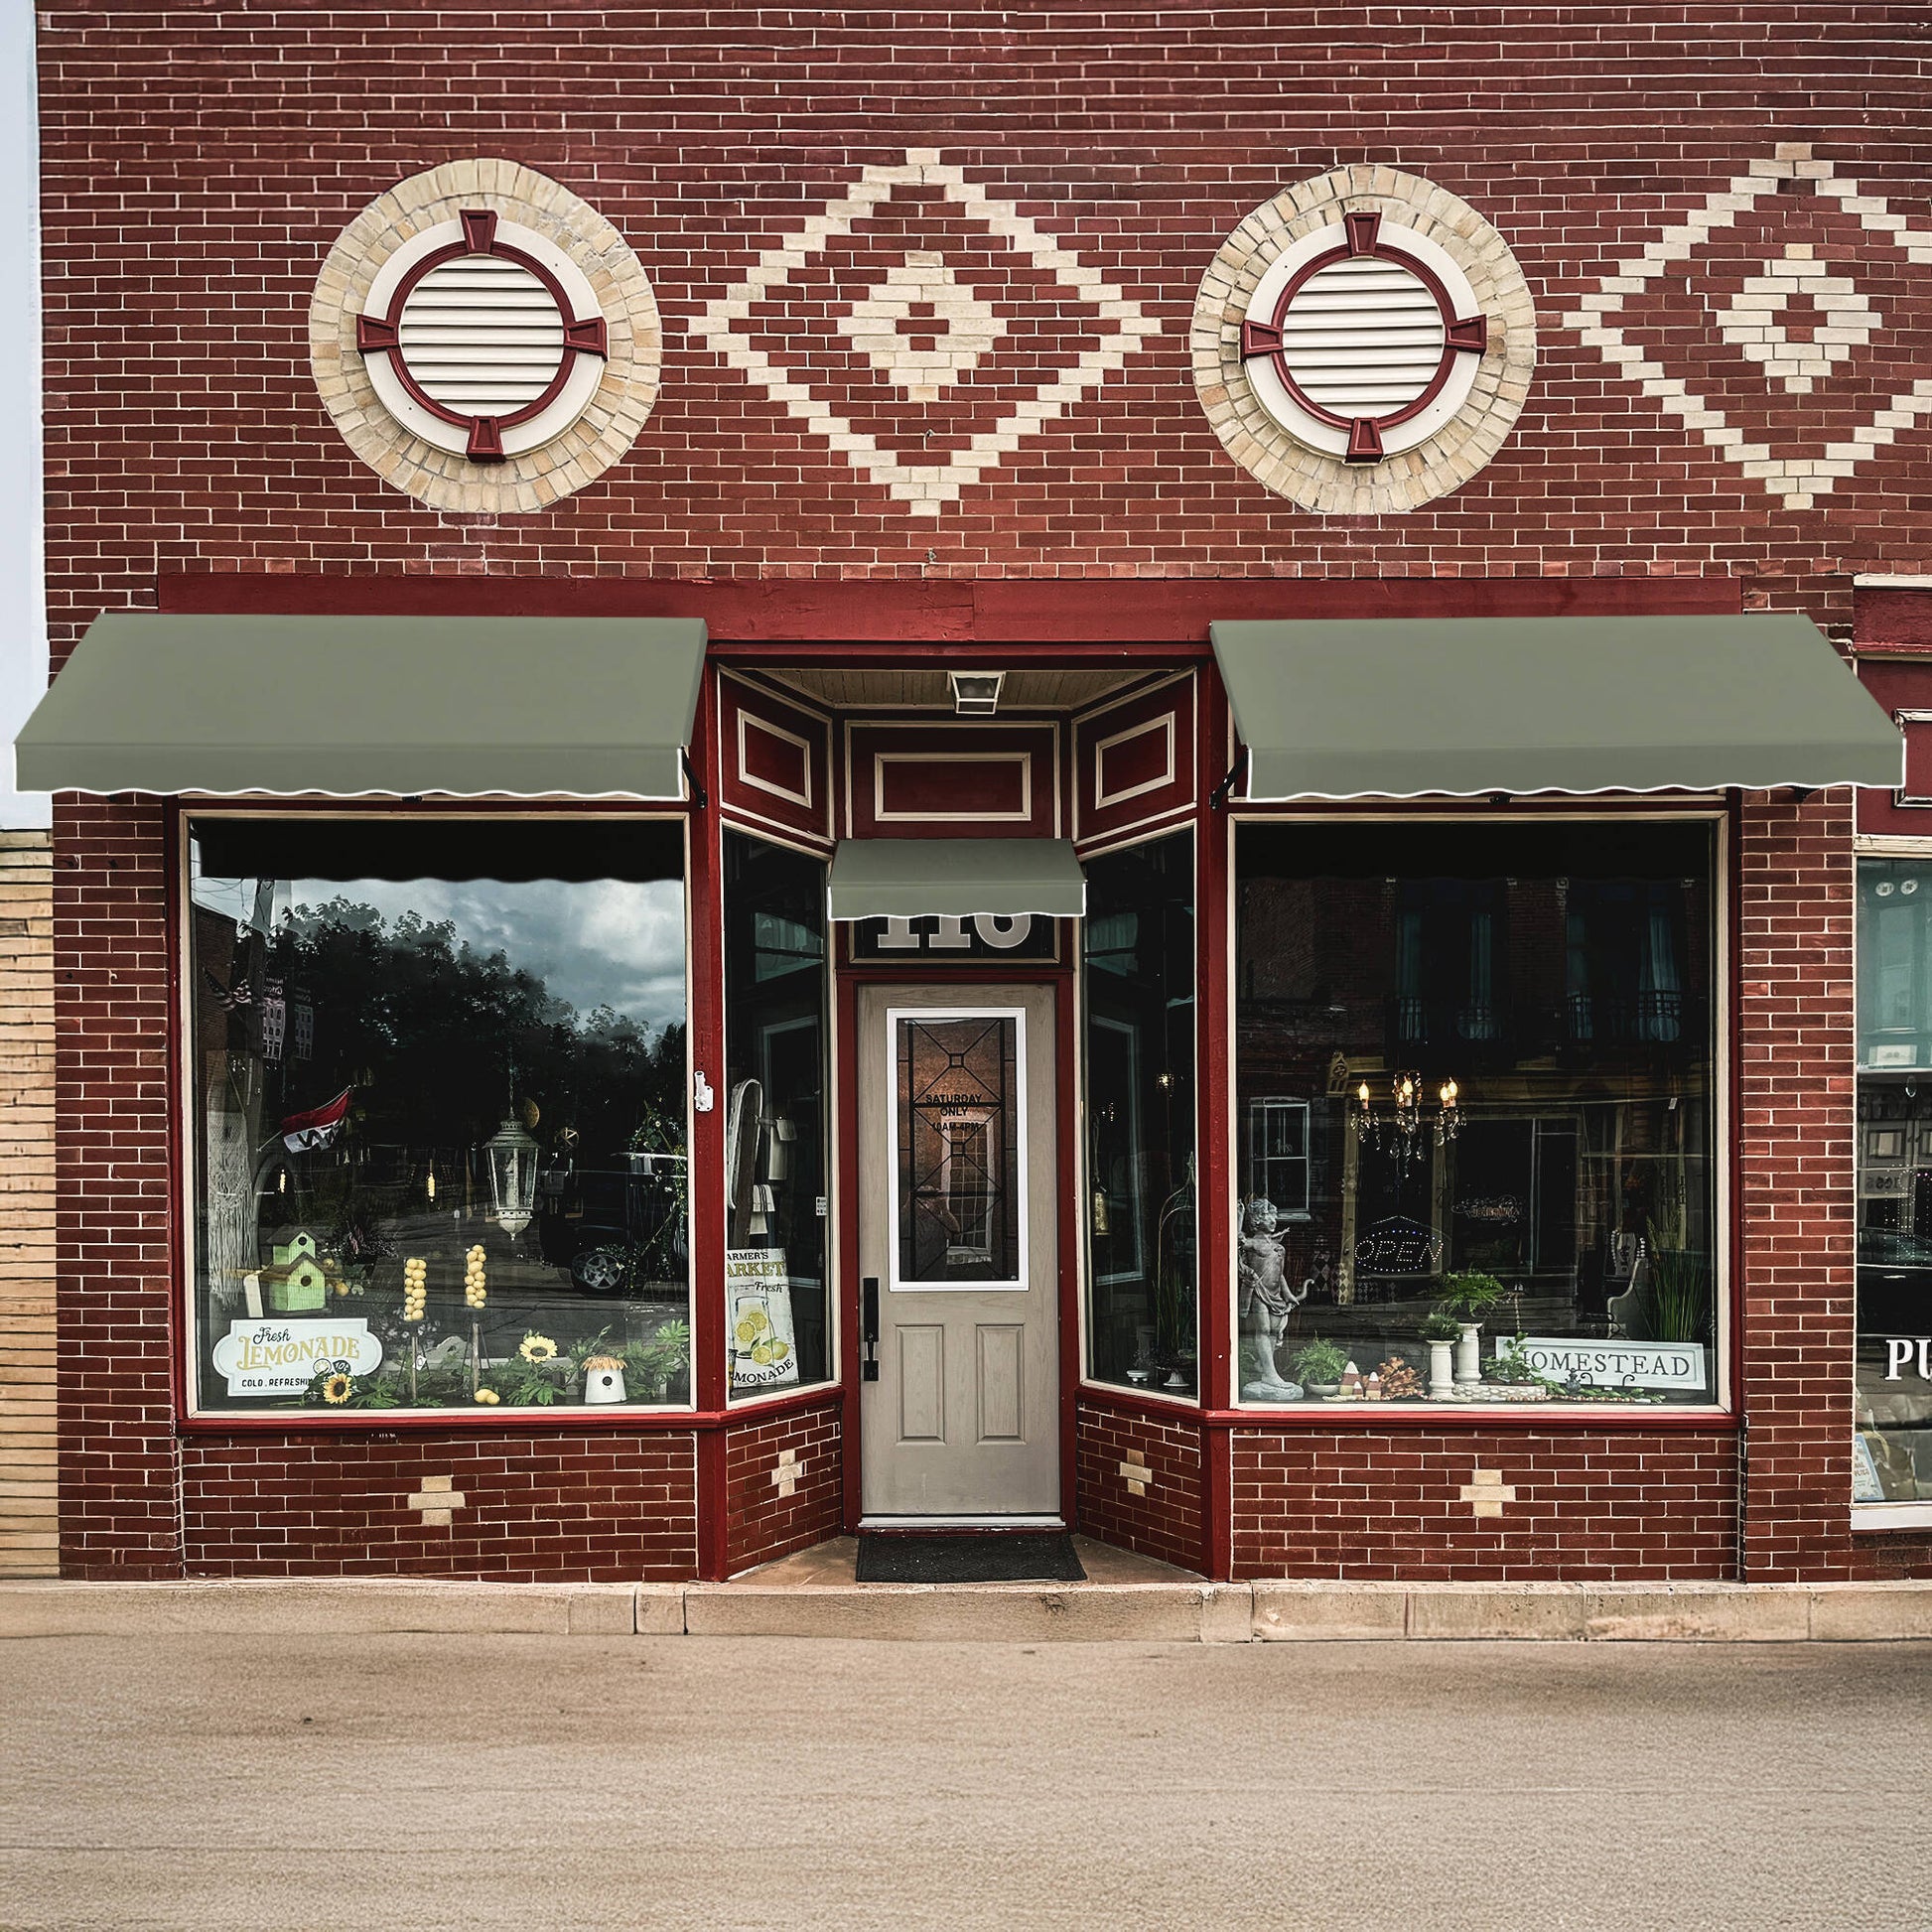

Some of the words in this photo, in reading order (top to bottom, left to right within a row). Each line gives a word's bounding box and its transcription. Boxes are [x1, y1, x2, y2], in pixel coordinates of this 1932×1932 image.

[925, 1094, 982, 1103] SATURDAY
[940, 1107, 968, 1116] ONLY
[1354, 1240, 1444, 1263] OPEN
[755, 1281, 782, 1294] Fresh
[252, 1326, 292, 1345] Fresh
[236, 1335, 360, 1371] LEMONADE
